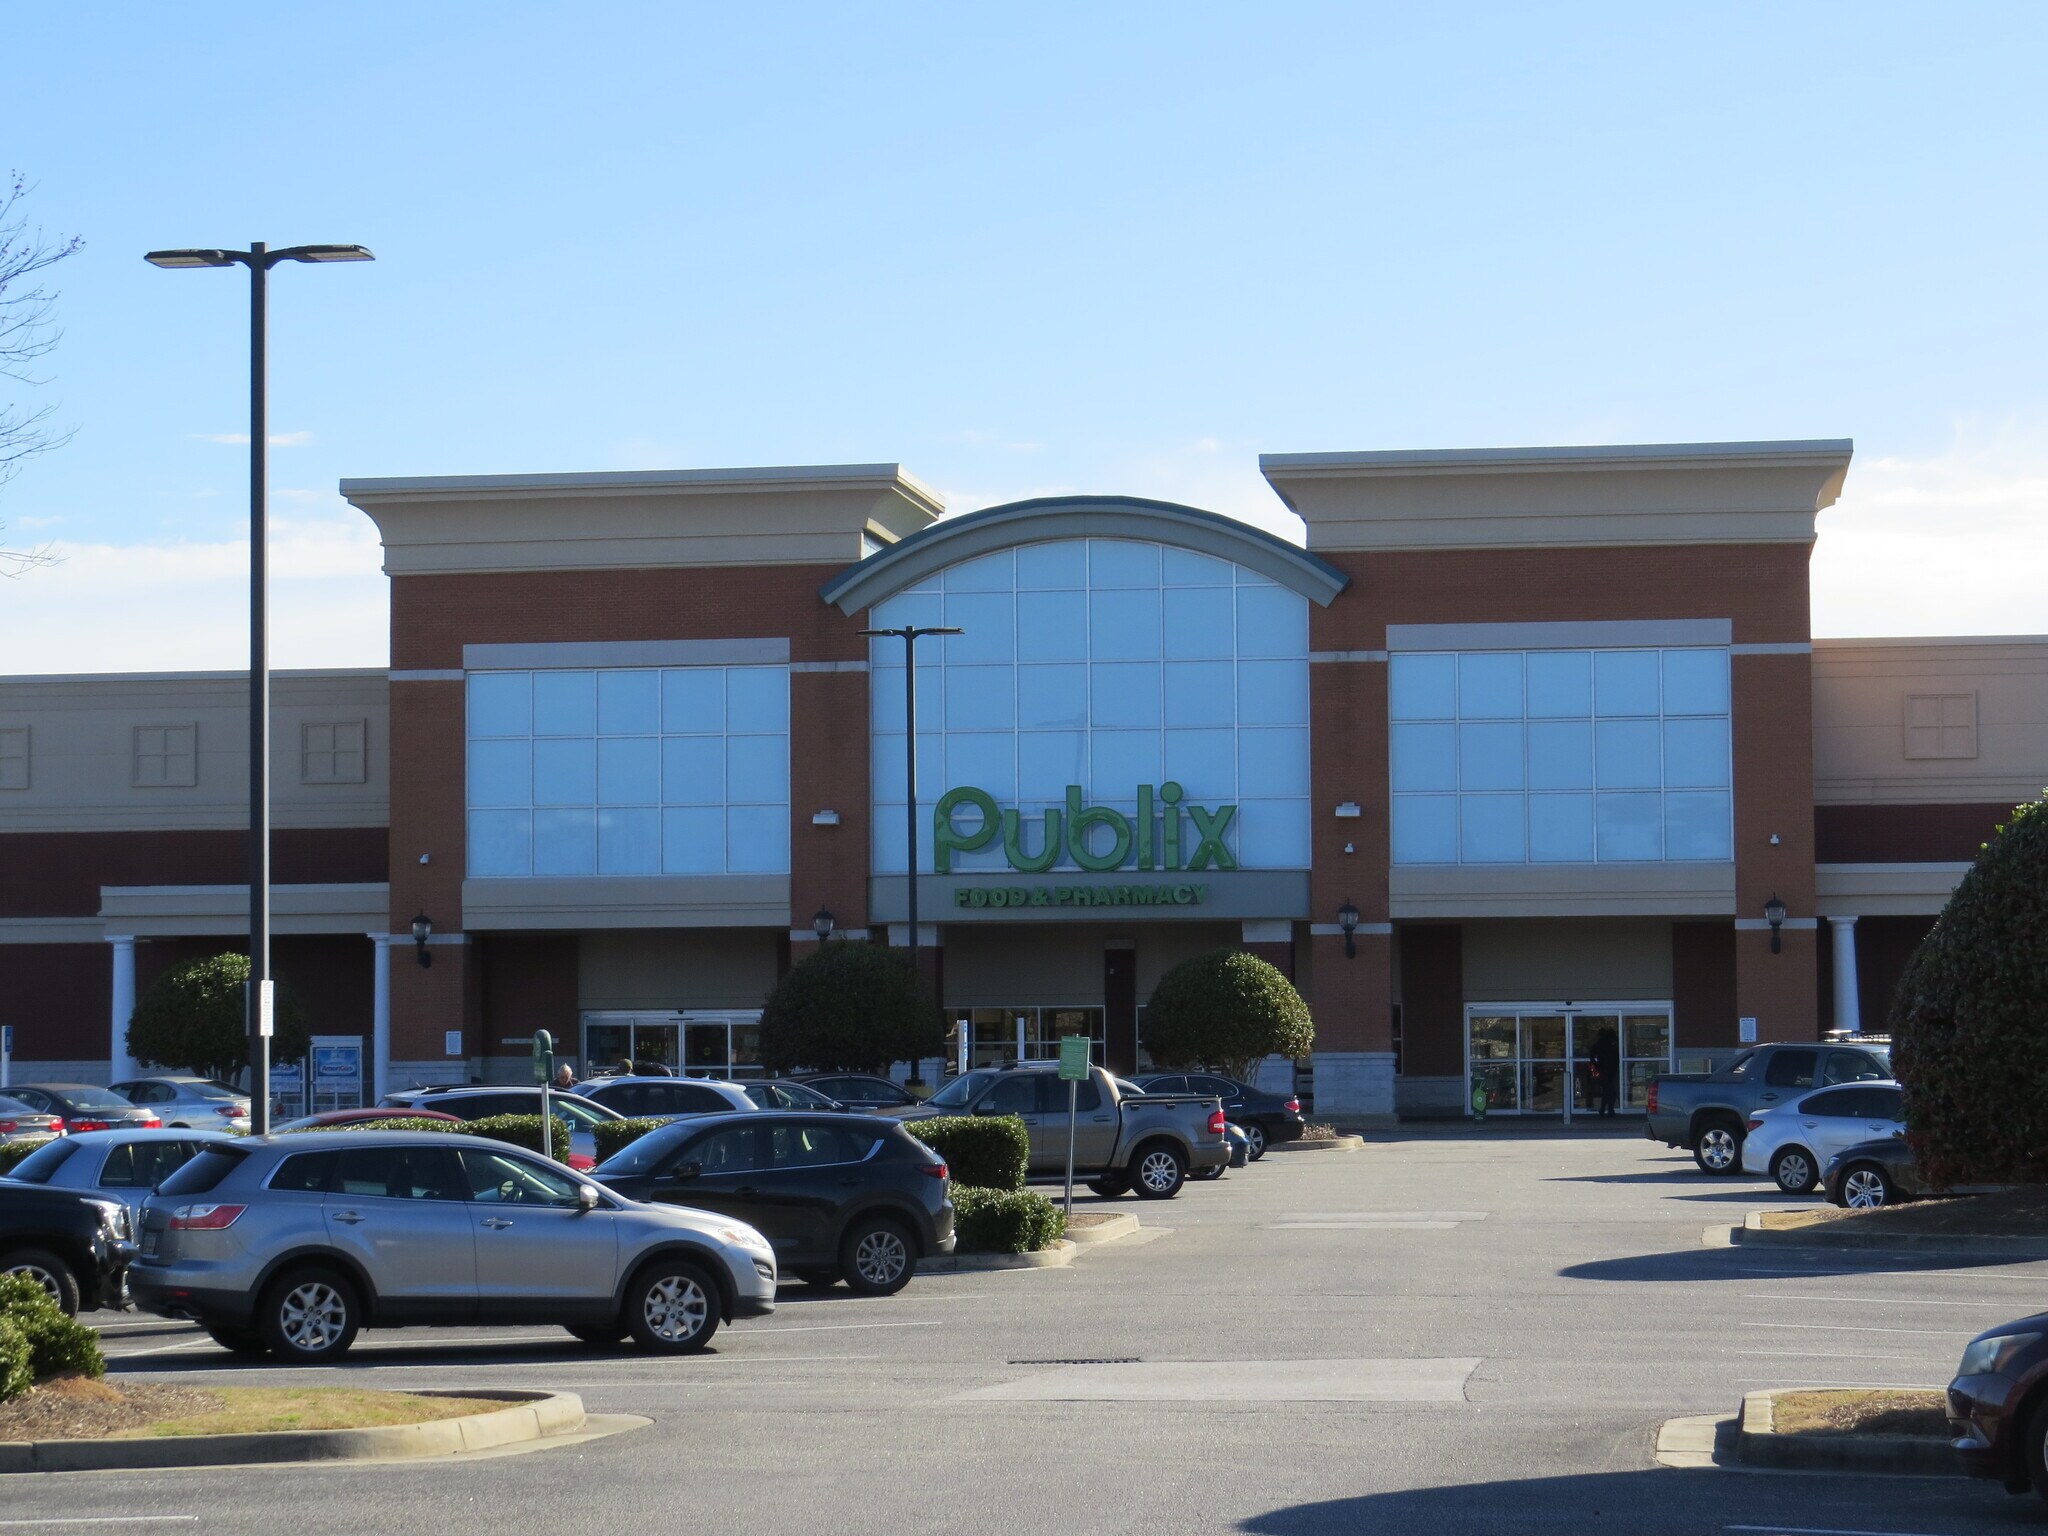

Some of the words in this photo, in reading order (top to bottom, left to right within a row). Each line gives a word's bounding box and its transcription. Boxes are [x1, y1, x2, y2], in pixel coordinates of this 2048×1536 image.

[934, 781, 1237, 874] Publix
[954, 887, 1024, 907] FOOD
[1031, 887, 1048, 906] &
[1055, 884, 1209, 906] PHARMACY
